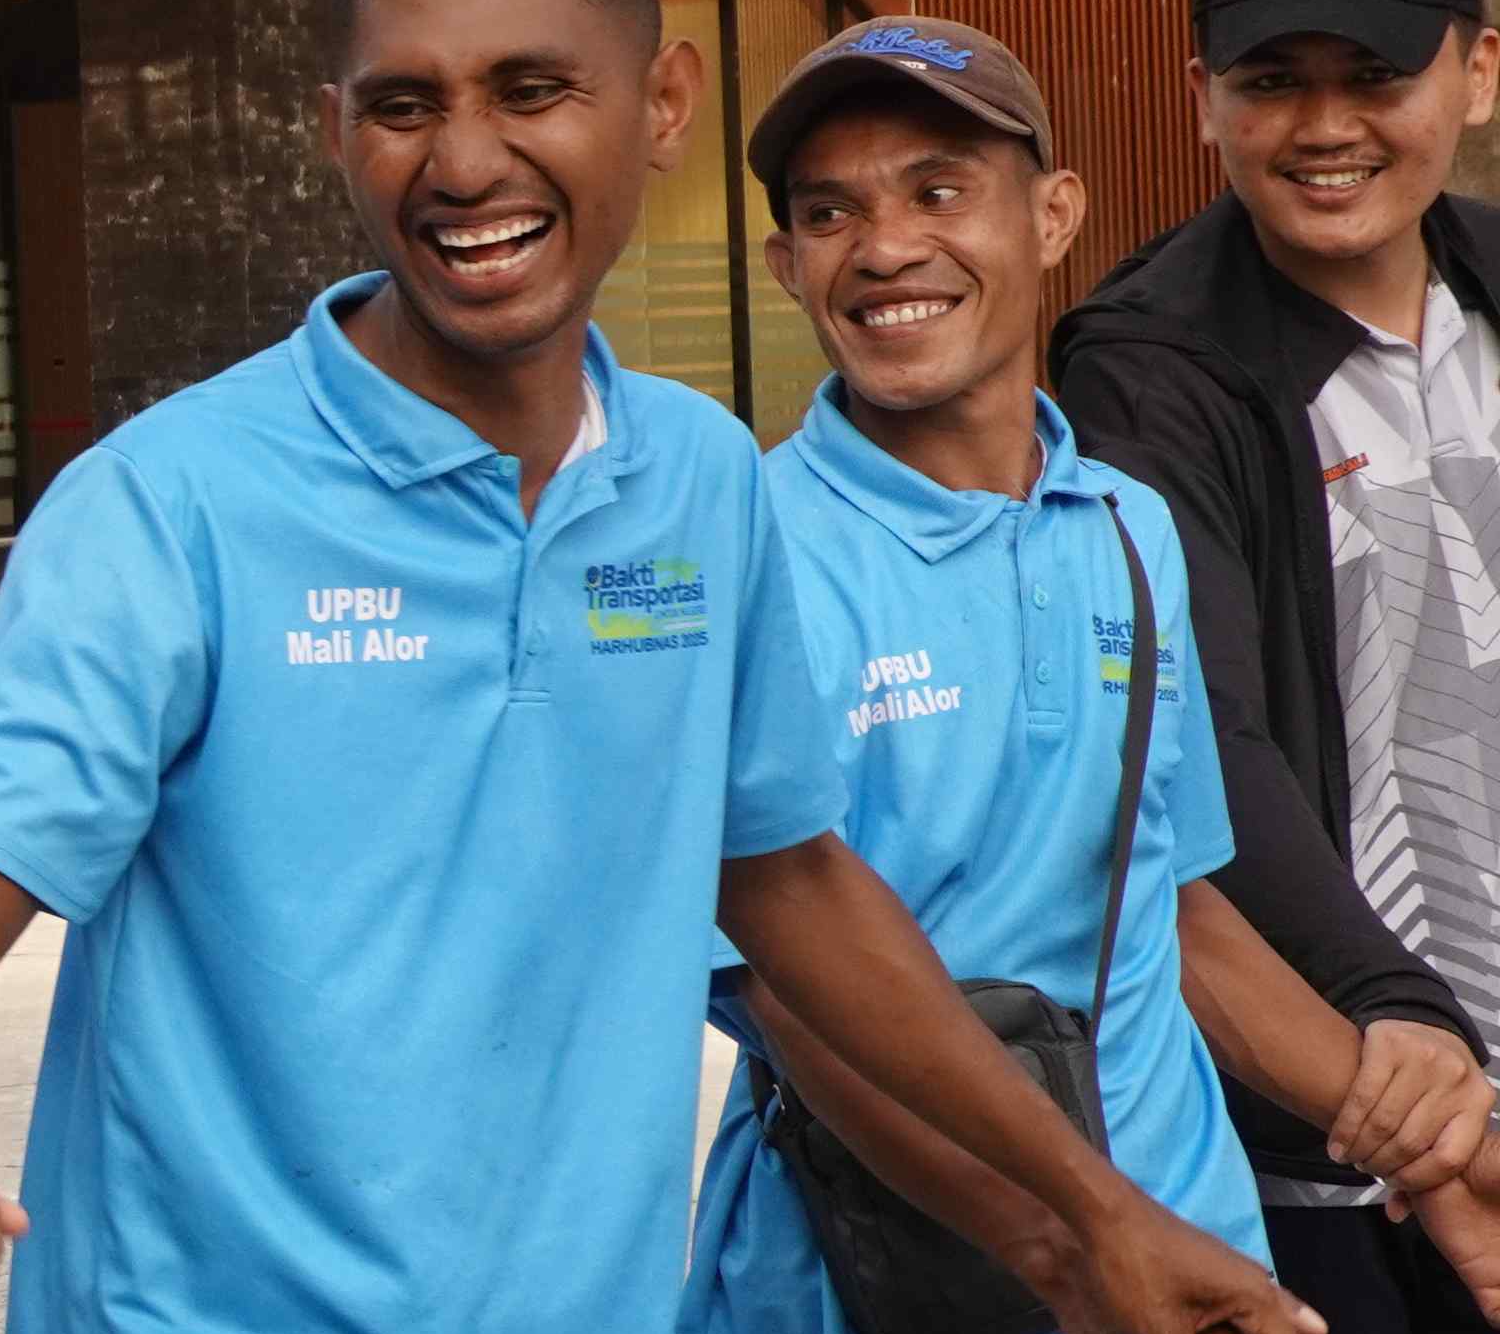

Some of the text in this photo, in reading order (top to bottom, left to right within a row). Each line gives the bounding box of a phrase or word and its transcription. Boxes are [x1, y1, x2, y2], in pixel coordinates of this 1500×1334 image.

[601, 559, 655, 589] Bakti
[306, 586, 402, 623] UPBU
[584, 573, 706, 614] Transportasi
[286, 627, 430, 665] Mali Alor
[847, 683, 962, 738] Mali Alor
